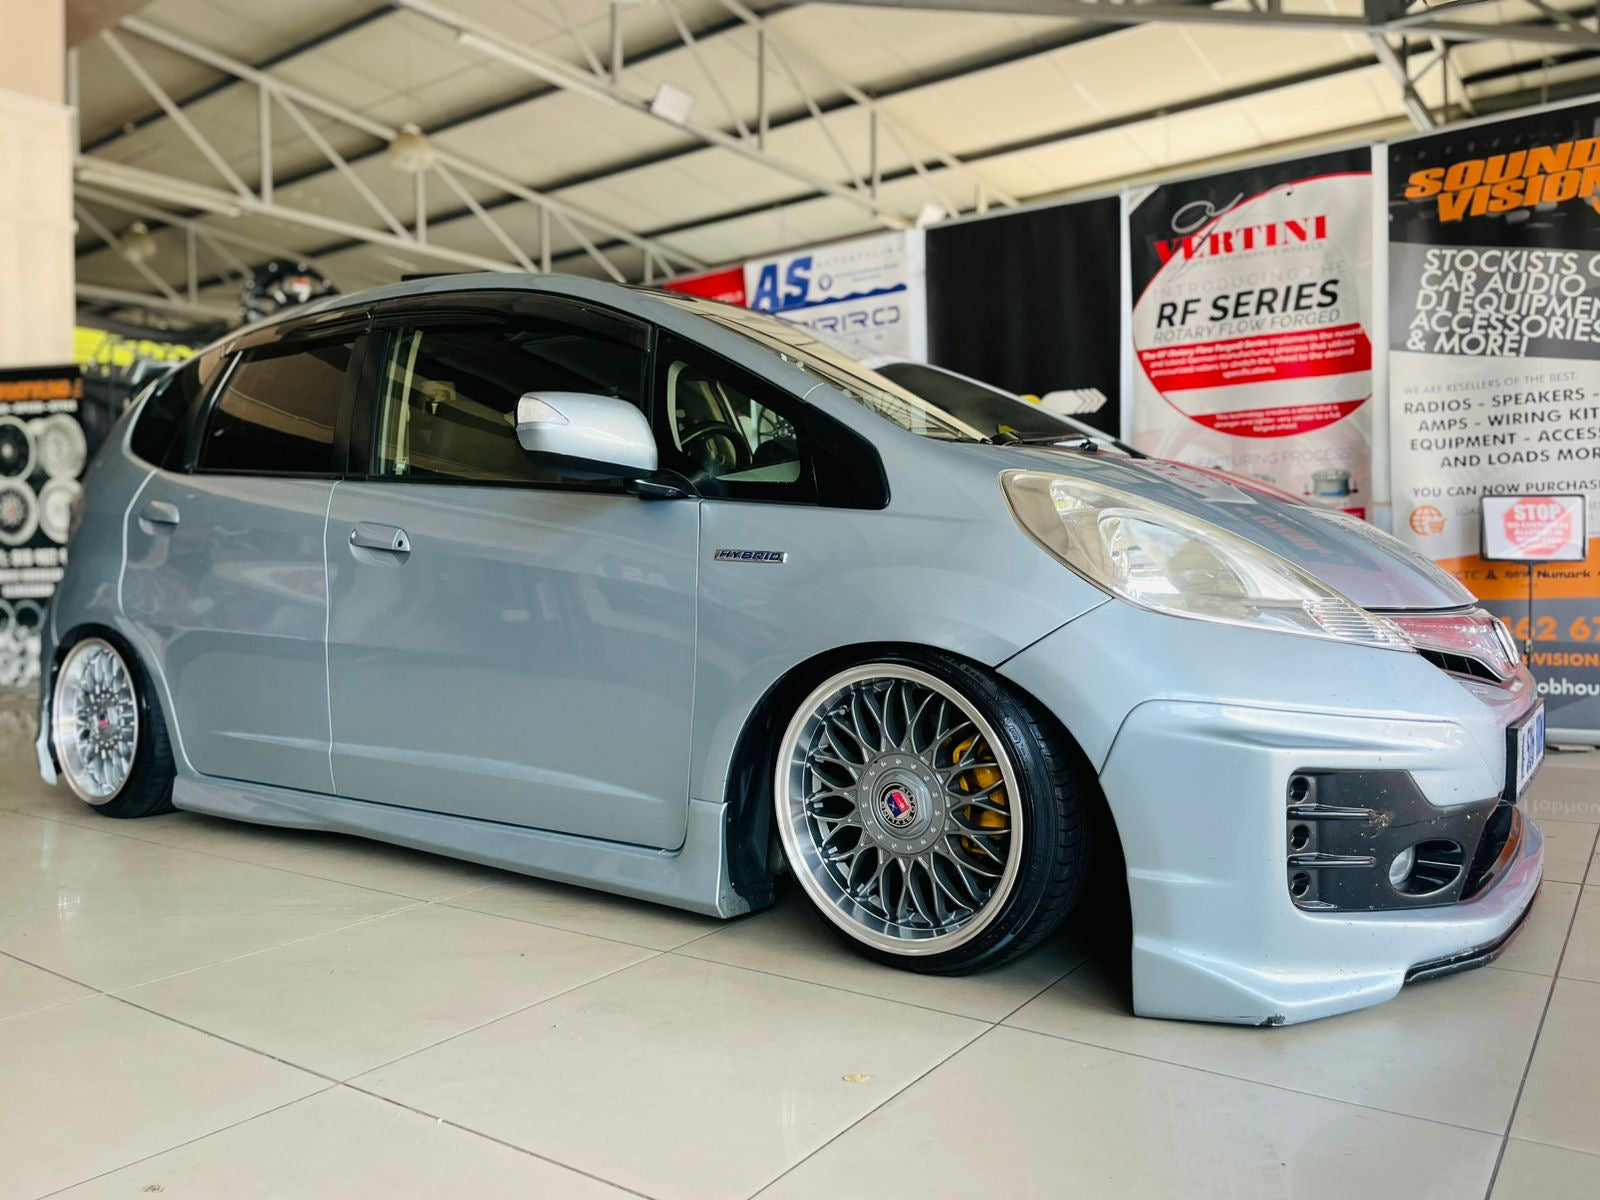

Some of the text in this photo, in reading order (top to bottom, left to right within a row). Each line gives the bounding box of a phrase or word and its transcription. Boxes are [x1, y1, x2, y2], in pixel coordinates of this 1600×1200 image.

[1405, 137, 1600, 198] SOUND
[1154, 214, 1327, 265] VERTINI
[1424, 248, 1579, 275] STOCKISTS
[751, 256, 813, 313] AS
[1420, 270, 1586, 298] CAR AUDIO
[1156, 278, 1339, 328] RF SERIES
[1415, 289, 1450, 312] DJ
[1153, 308, 1341, 345] ROTARY FLOW FORGED
[1406, 329, 1530, 357] & MORE!
[1404, 386, 1419, 395] WE
[1423, 384, 1442, 395] ARE
[1446, 378, 1500, 393] RESELLERS
[1504, 375, 1519, 386] OF
[1525, 373, 1545, 384] THE
[1404, 398, 1472, 415] RADIOS
[1492, 388, 1585, 407] SPEAKERS
[1418, 417, 1468, 433] AMPS
[1487, 409, 1562, 427] WIRING
[1410, 432, 1517, 451] EQUIPMENT
[1441, 455, 1481, 469] AND
[1488, 449, 1550, 466] LOADS
[1412, 486, 1442, 498] YOU
[1447, 485, 1477, 497] CAN
[1482, 482, 1520, 496] NOW
[1514, 503, 1561, 521] STOP
[716, 550, 781, 561] HYBRID
[1537, 569, 1592, 580] Numark
